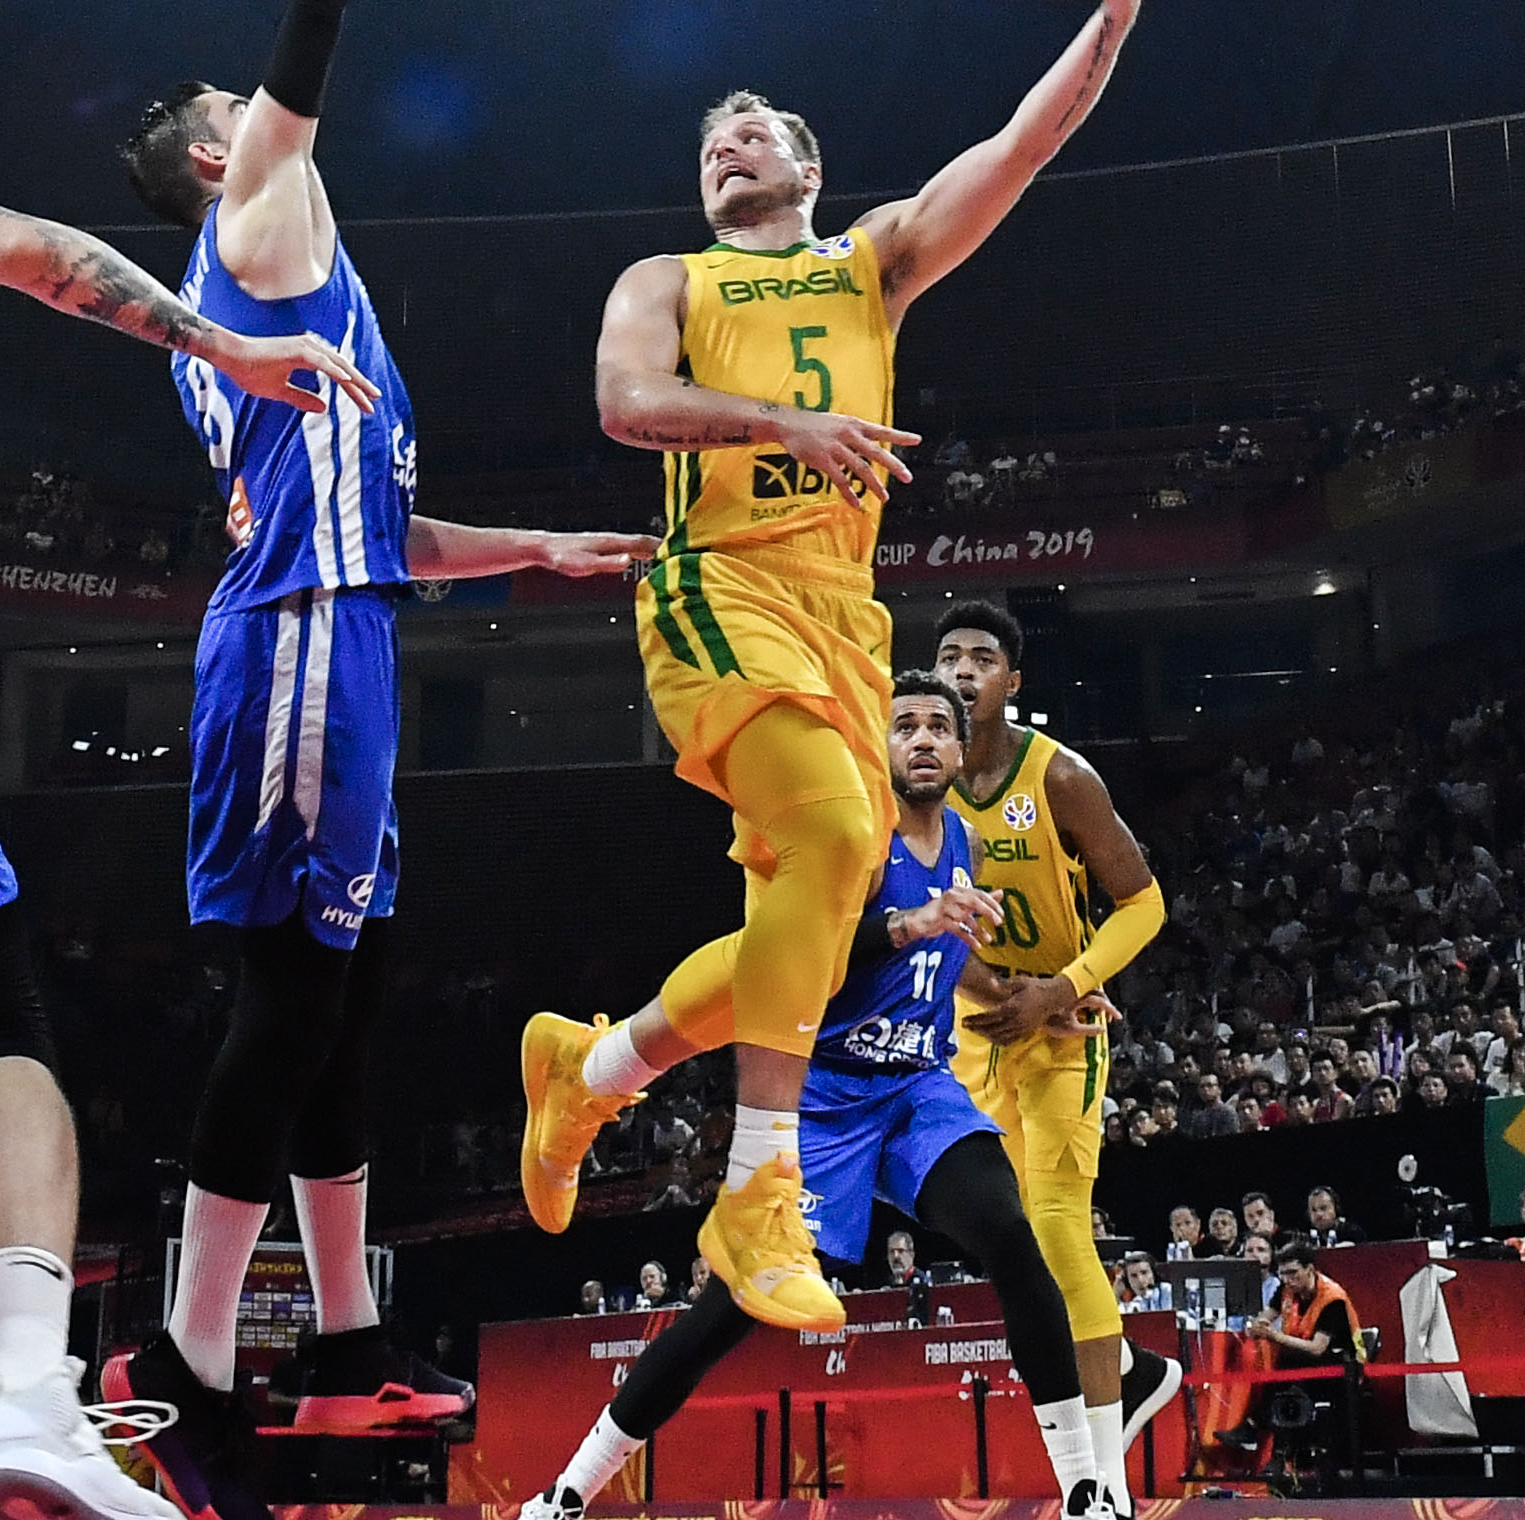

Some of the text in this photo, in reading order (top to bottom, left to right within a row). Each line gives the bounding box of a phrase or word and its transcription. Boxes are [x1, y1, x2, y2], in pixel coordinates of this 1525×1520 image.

[718, 267, 863, 307] BRASIL
[789, 325, 832, 413] 5
[876, 543, 916, 566] CUP
[926, 534, 1019, 567] China
[1026, 527, 1094, 559] 2019
[908, 950, 942, 1002] 11
[925, 1343, 948, 1364] FIBA
